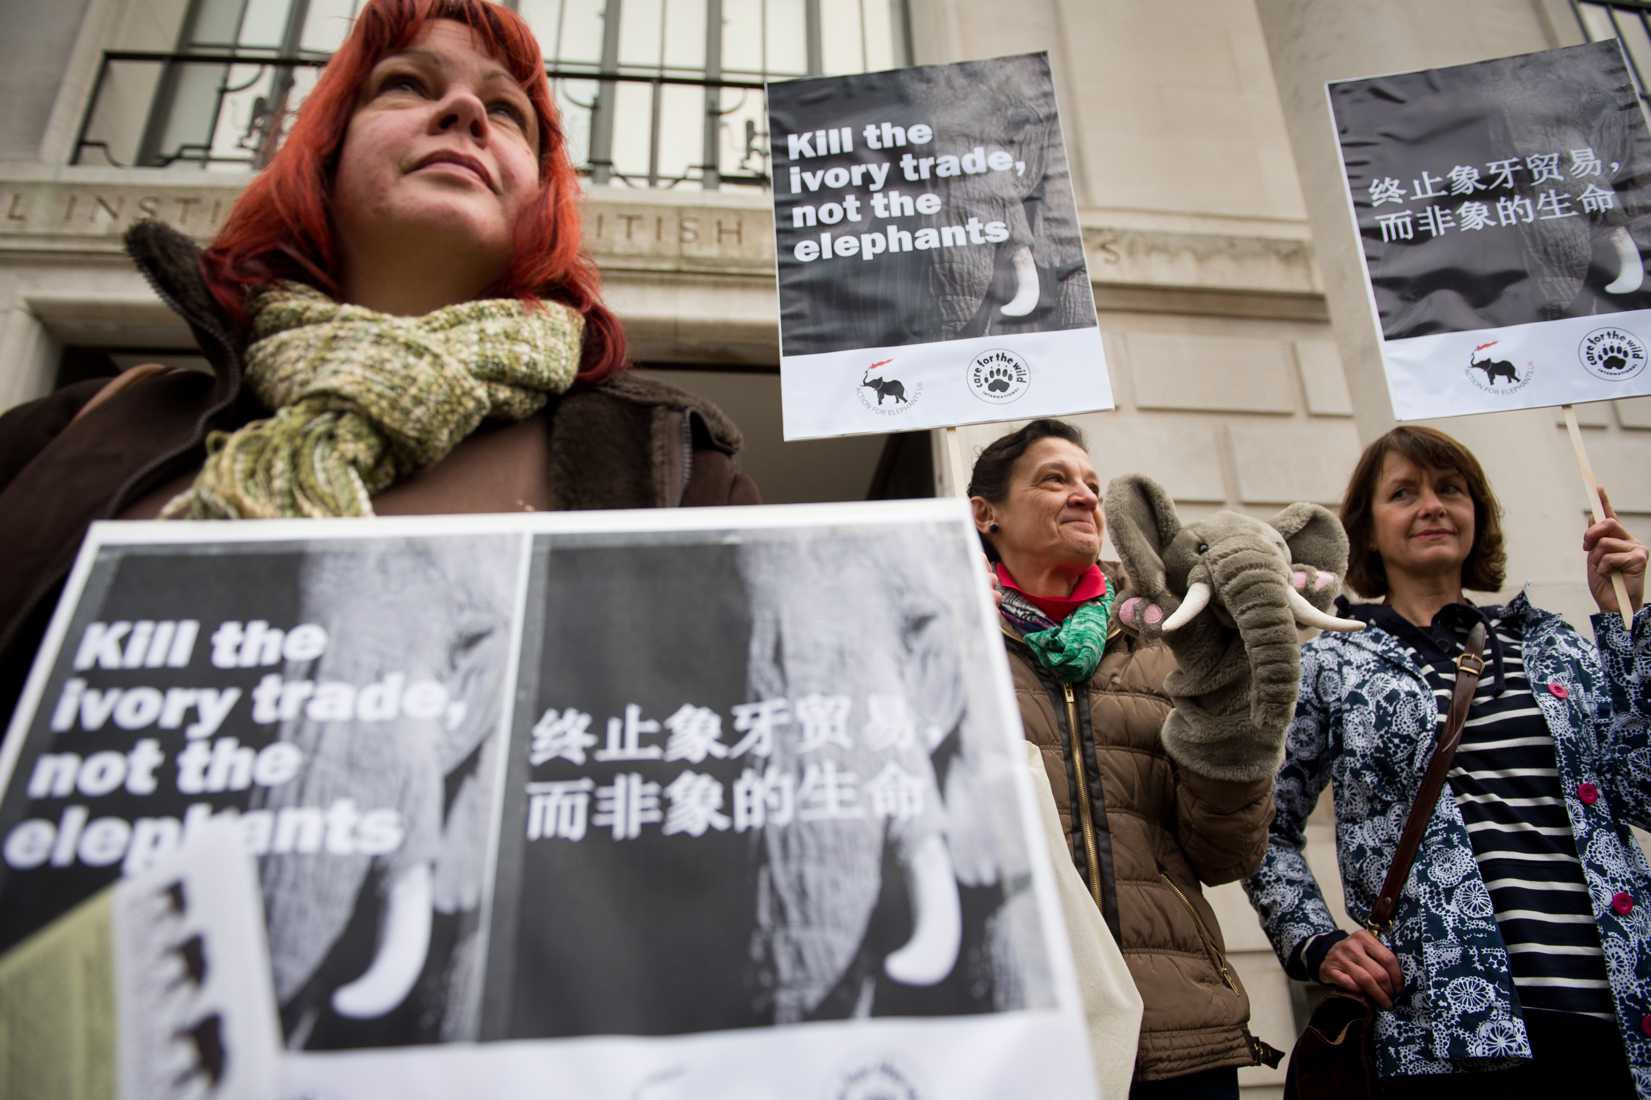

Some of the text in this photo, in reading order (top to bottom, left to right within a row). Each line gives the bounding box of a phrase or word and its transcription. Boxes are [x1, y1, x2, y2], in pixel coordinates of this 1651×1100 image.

[787, 122, 933, 160] Kill the
[789, 147, 1026, 194] ivory trade,
[792, 190, 942, 228] not the
[1375, 183, 1615, 243] 而非象的生命
[794, 217, 1010, 262] elephants
[973, 352, 1027, 388] care for the wild
[1586, 330, 1644, 366] care for the wild
[74, 620, 328, 671] Kill the
[51, 672, 468, 740] ivory trade,
[28, 736, 302, 798] not the
[524, 759, 926, 841] 而非象的生命
